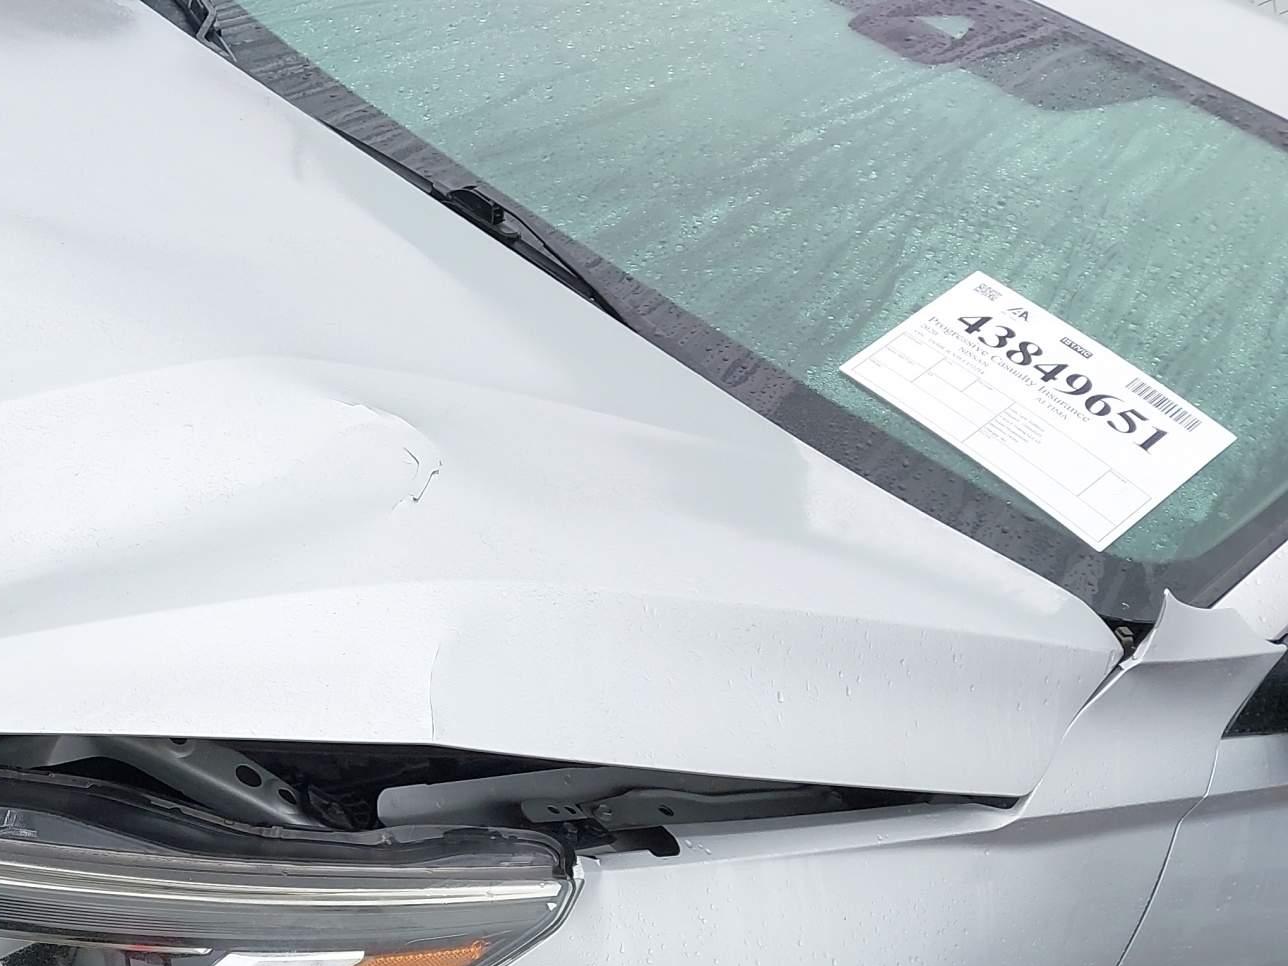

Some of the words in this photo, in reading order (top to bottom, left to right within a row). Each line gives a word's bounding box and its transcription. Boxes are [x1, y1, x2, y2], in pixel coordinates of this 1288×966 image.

[928, 316, 989, 356] Progressive
[990, 356, 1037, 386] Casualty
[1037, 386, 1090, 422] Insurance
[957, 316, 1168, 453] 43849651
